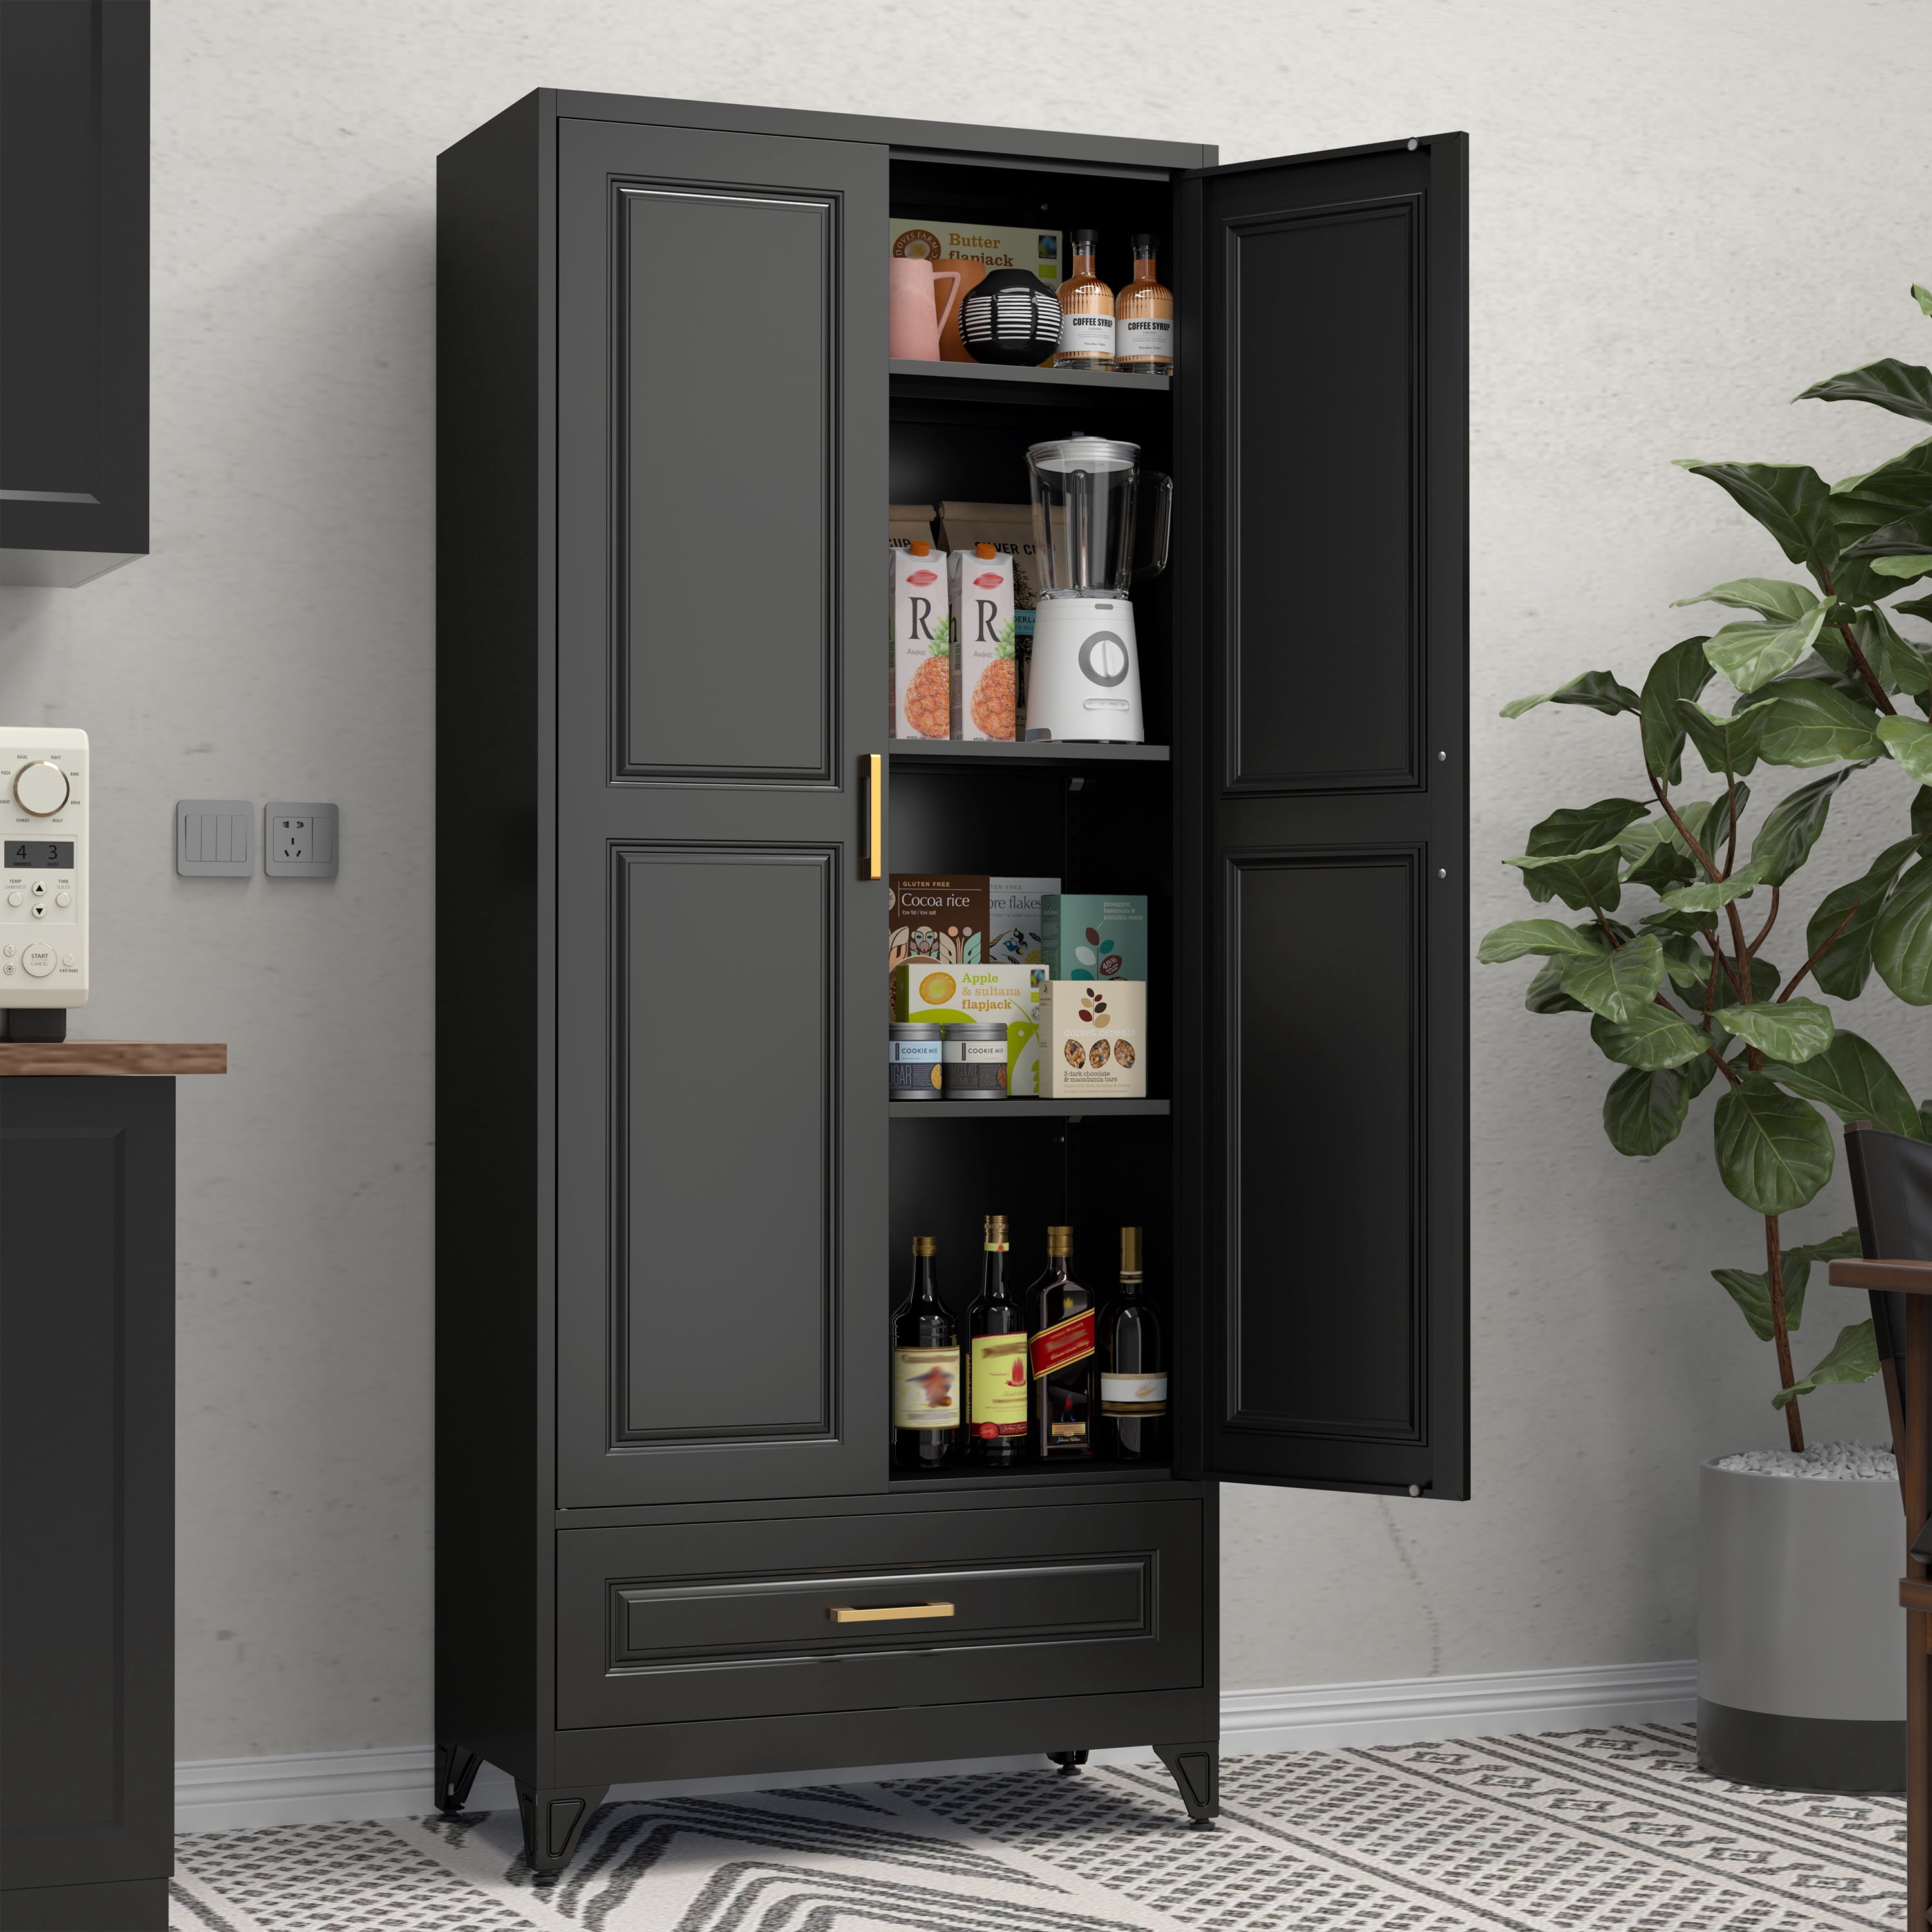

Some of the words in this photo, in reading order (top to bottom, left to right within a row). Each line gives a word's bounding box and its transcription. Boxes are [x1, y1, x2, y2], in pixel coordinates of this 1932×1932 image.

[896, 232, 915, 256] DOVES
[917, 232, 938, 249] FARM
[949, 233, 1001, 249] Butter
[1073, 317, 1097, 326] COFFEE
[1097, 319, 1113, 328] SYRUP
[1128, 322, 1151, 330] COFFEE
[1152, 323, 1170, 331] SYRUP
[908, 596, 935, 640] R
[974, 599, 1001, 643] R
[16, 845, 27, 859] 4
[48, 845, 57, 860] 3
[902, 893, 943, 907] Cocoa
[947, 894, 970, 907] rice
[1010, 895, 1041, 909] flakes
[1103, 957, 1117, 970] 45%
[961, 973, 999, 985] Apple
[961, 986, 972, 996] &
[975, 987, 1021, 996] sultana
[961, 999, 1012, 1012] flapjack
[1063, 1028, 1097, 1036] dorset
[1099, 1028, 1136, 1036] cereals
